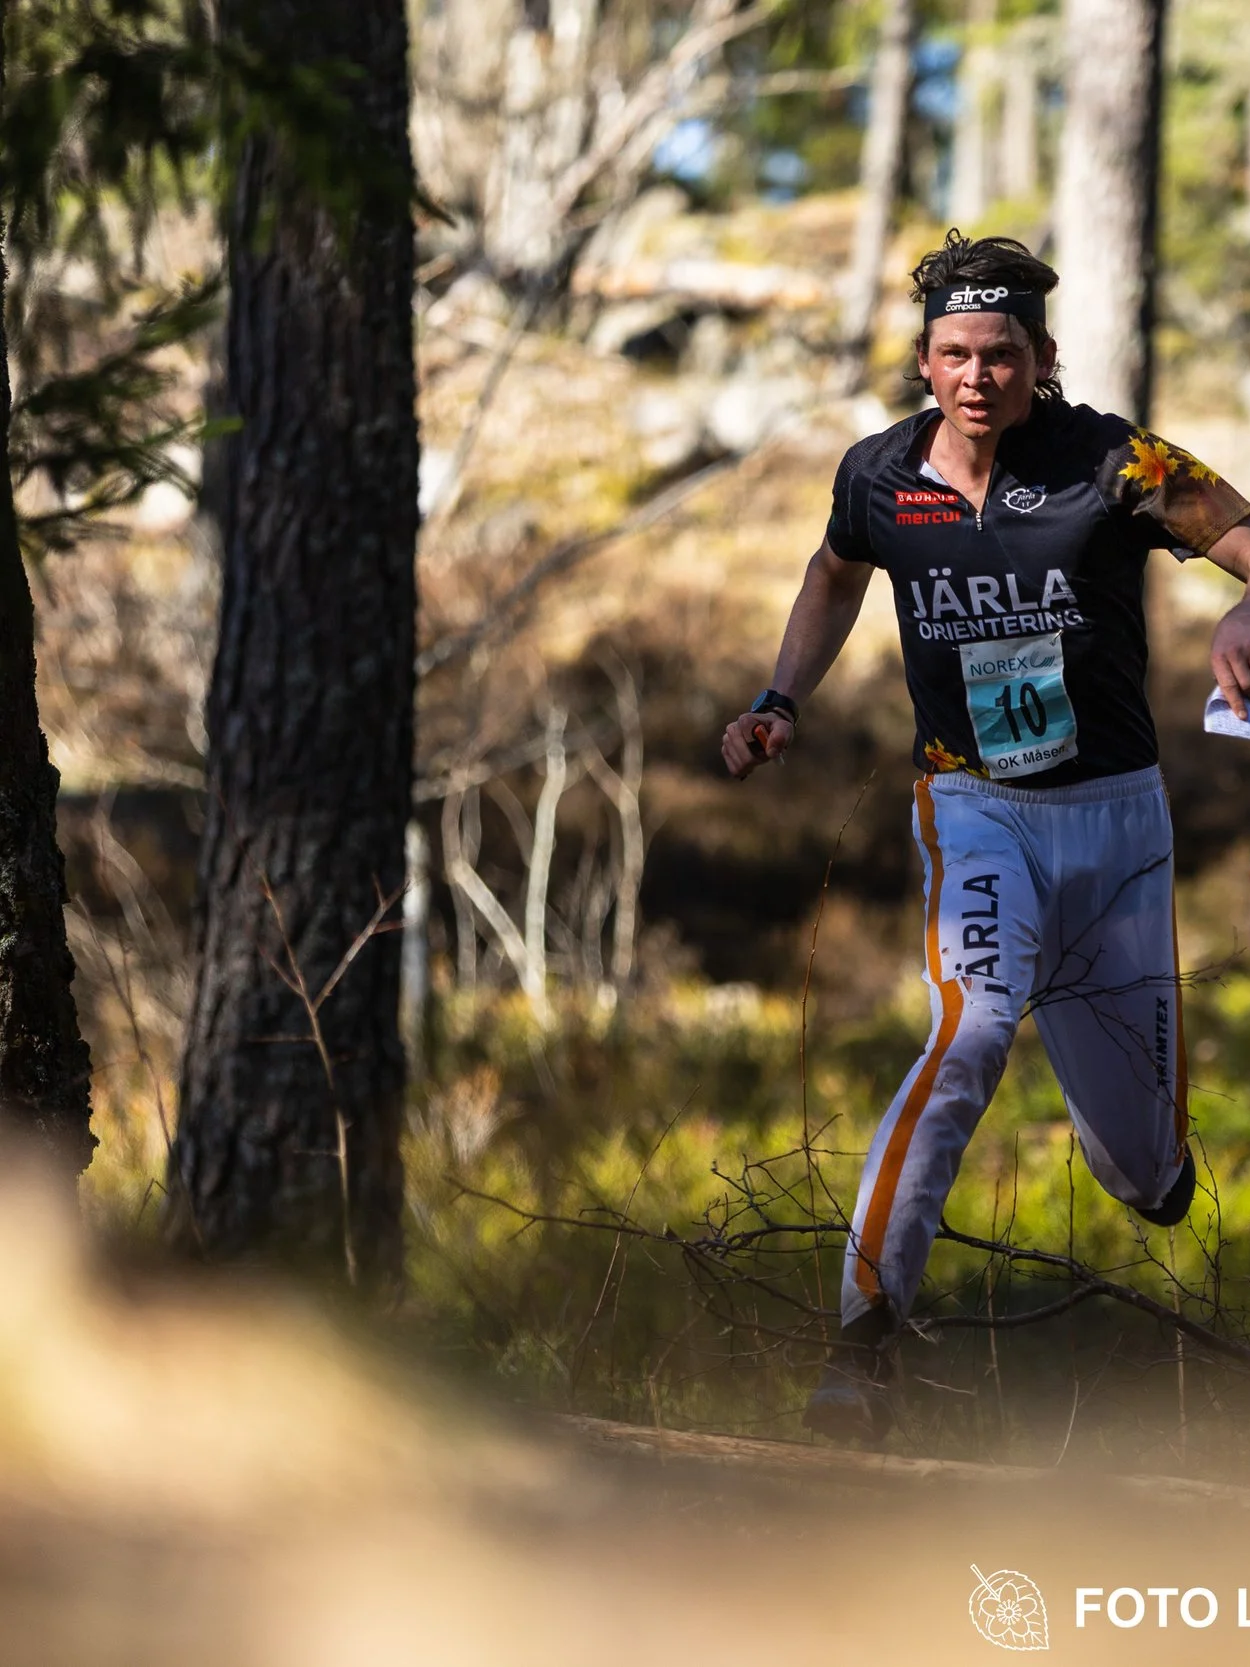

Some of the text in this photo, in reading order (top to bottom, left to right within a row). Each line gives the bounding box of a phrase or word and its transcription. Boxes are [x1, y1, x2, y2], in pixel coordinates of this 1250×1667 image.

[911, 568, 1078, 619] JÄRLA
[919, 608, 1084, 640] ORIENTERING
[970, 656, 1029, 677] NOREX
[995, 681, 1047, 743] 10
[998, 756, 1020, 770] OK
